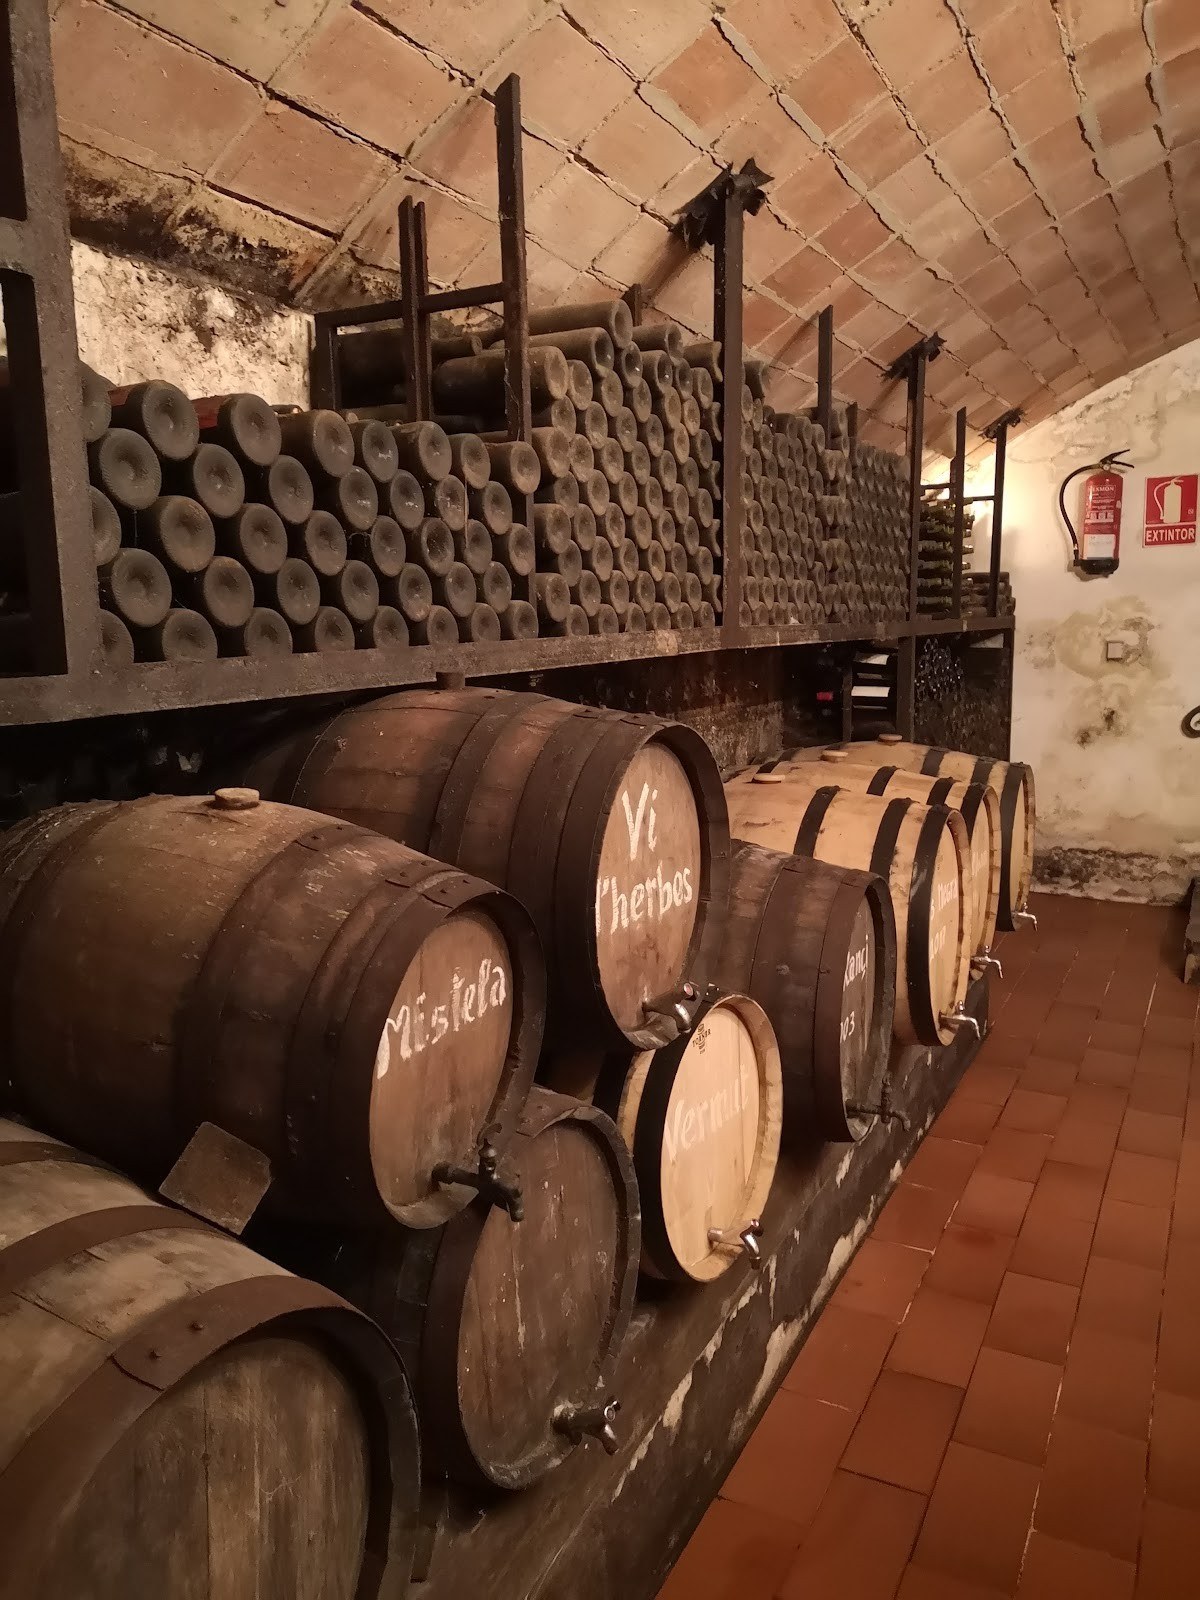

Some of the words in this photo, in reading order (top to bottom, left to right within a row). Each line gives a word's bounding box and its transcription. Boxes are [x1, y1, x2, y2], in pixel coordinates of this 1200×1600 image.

[1146, 528, 1195, 542] EXTINTOR
[621, 782, 658, 861] Vi
[377, 958, 507, 1080] Mistela
